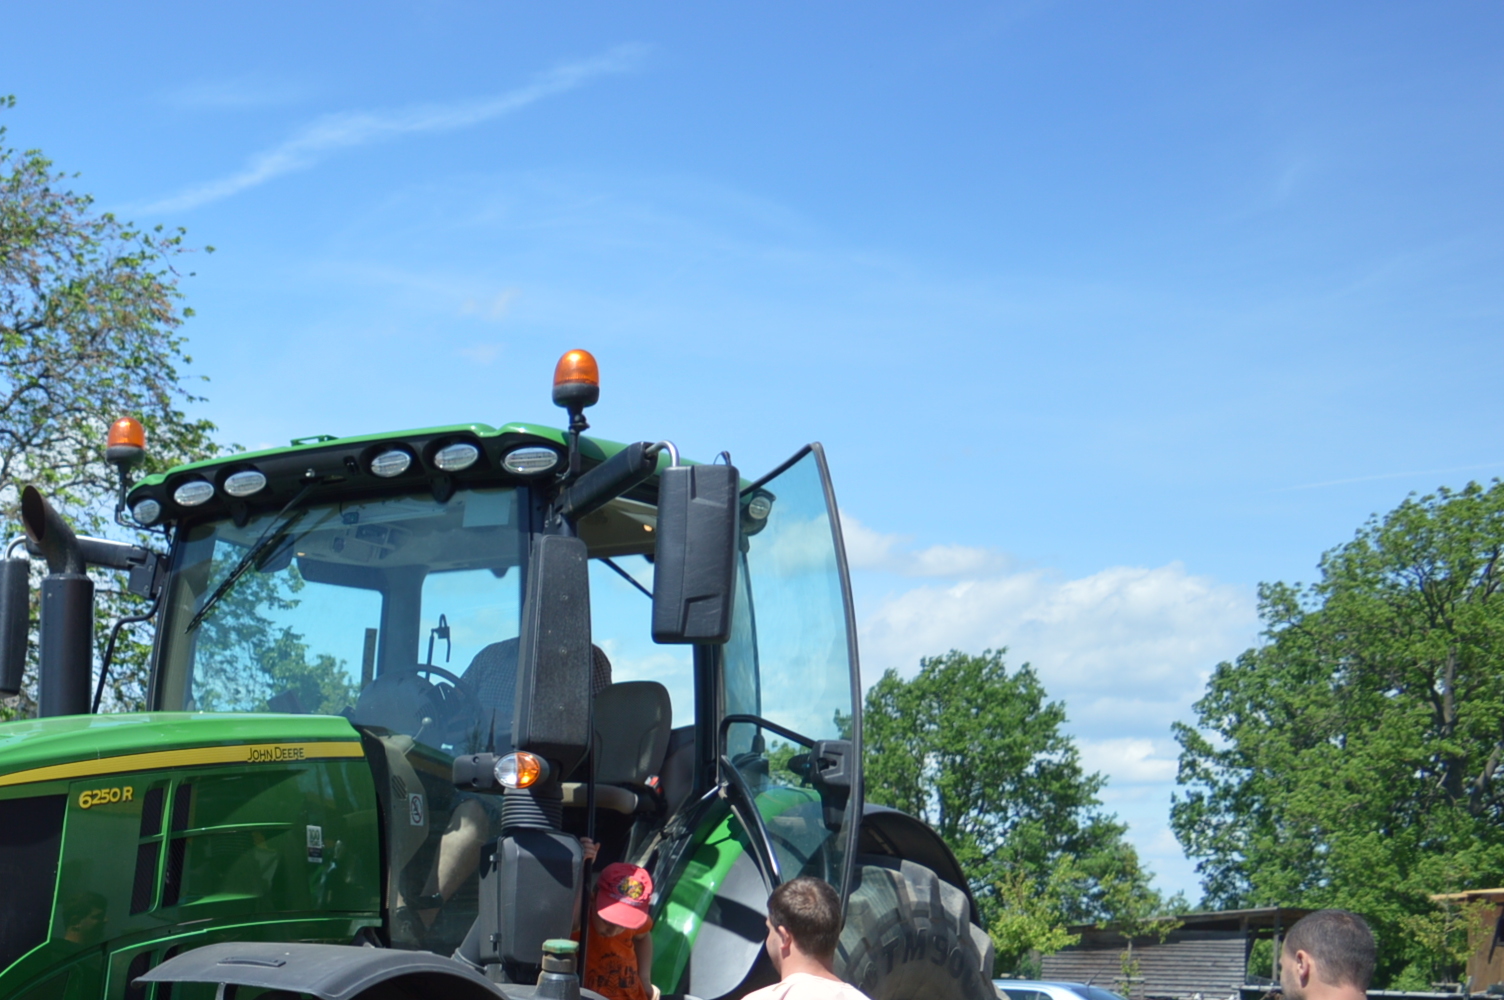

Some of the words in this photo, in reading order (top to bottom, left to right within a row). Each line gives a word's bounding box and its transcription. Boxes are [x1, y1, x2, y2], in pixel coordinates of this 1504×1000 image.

[247, 747, 273, 761] JOHN
[274, 746, 305, 760] DEERE
[78, 787, 121, 809] 6250
[122, 785, 134, 801] R
